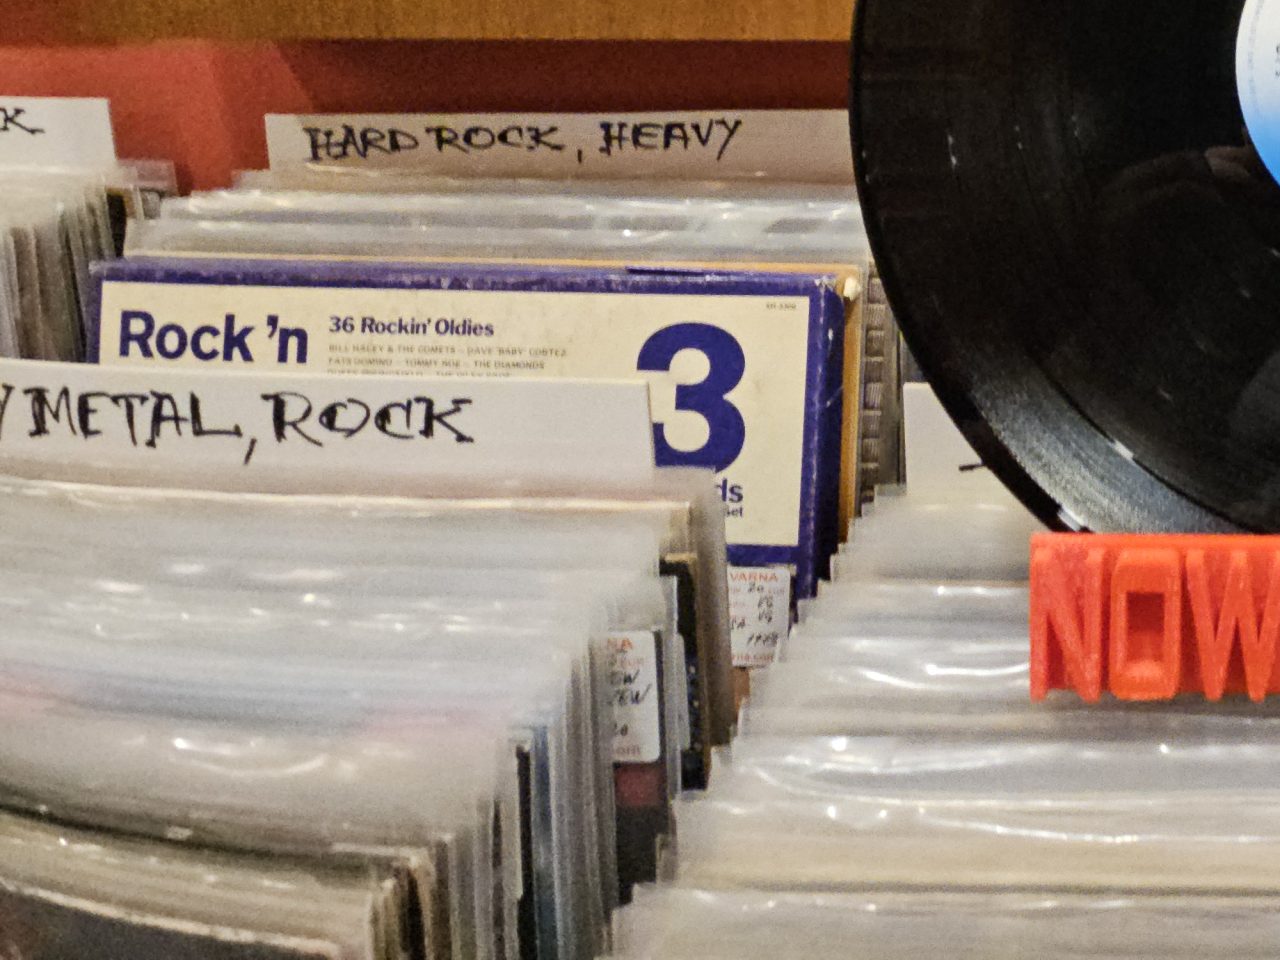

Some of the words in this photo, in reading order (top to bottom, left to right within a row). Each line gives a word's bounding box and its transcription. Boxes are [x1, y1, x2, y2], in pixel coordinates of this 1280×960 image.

[303, 122, 419, 163] HARD
[599, 118, 743, 162] HEAVY
[118, 309, 256, 364] Rock
[328, 315, 356, 335] 36
[360, 316, 432, 335] Rockin'
[434, 317, 495, 337] Oldies
[397, 344, 415, 353] THE
[474, 359, 491, 369] THE
[636, 322, 746, 474] 3
[261, 391, 475, 448] ROCK
[729, 572, 779, 582] VARNA
